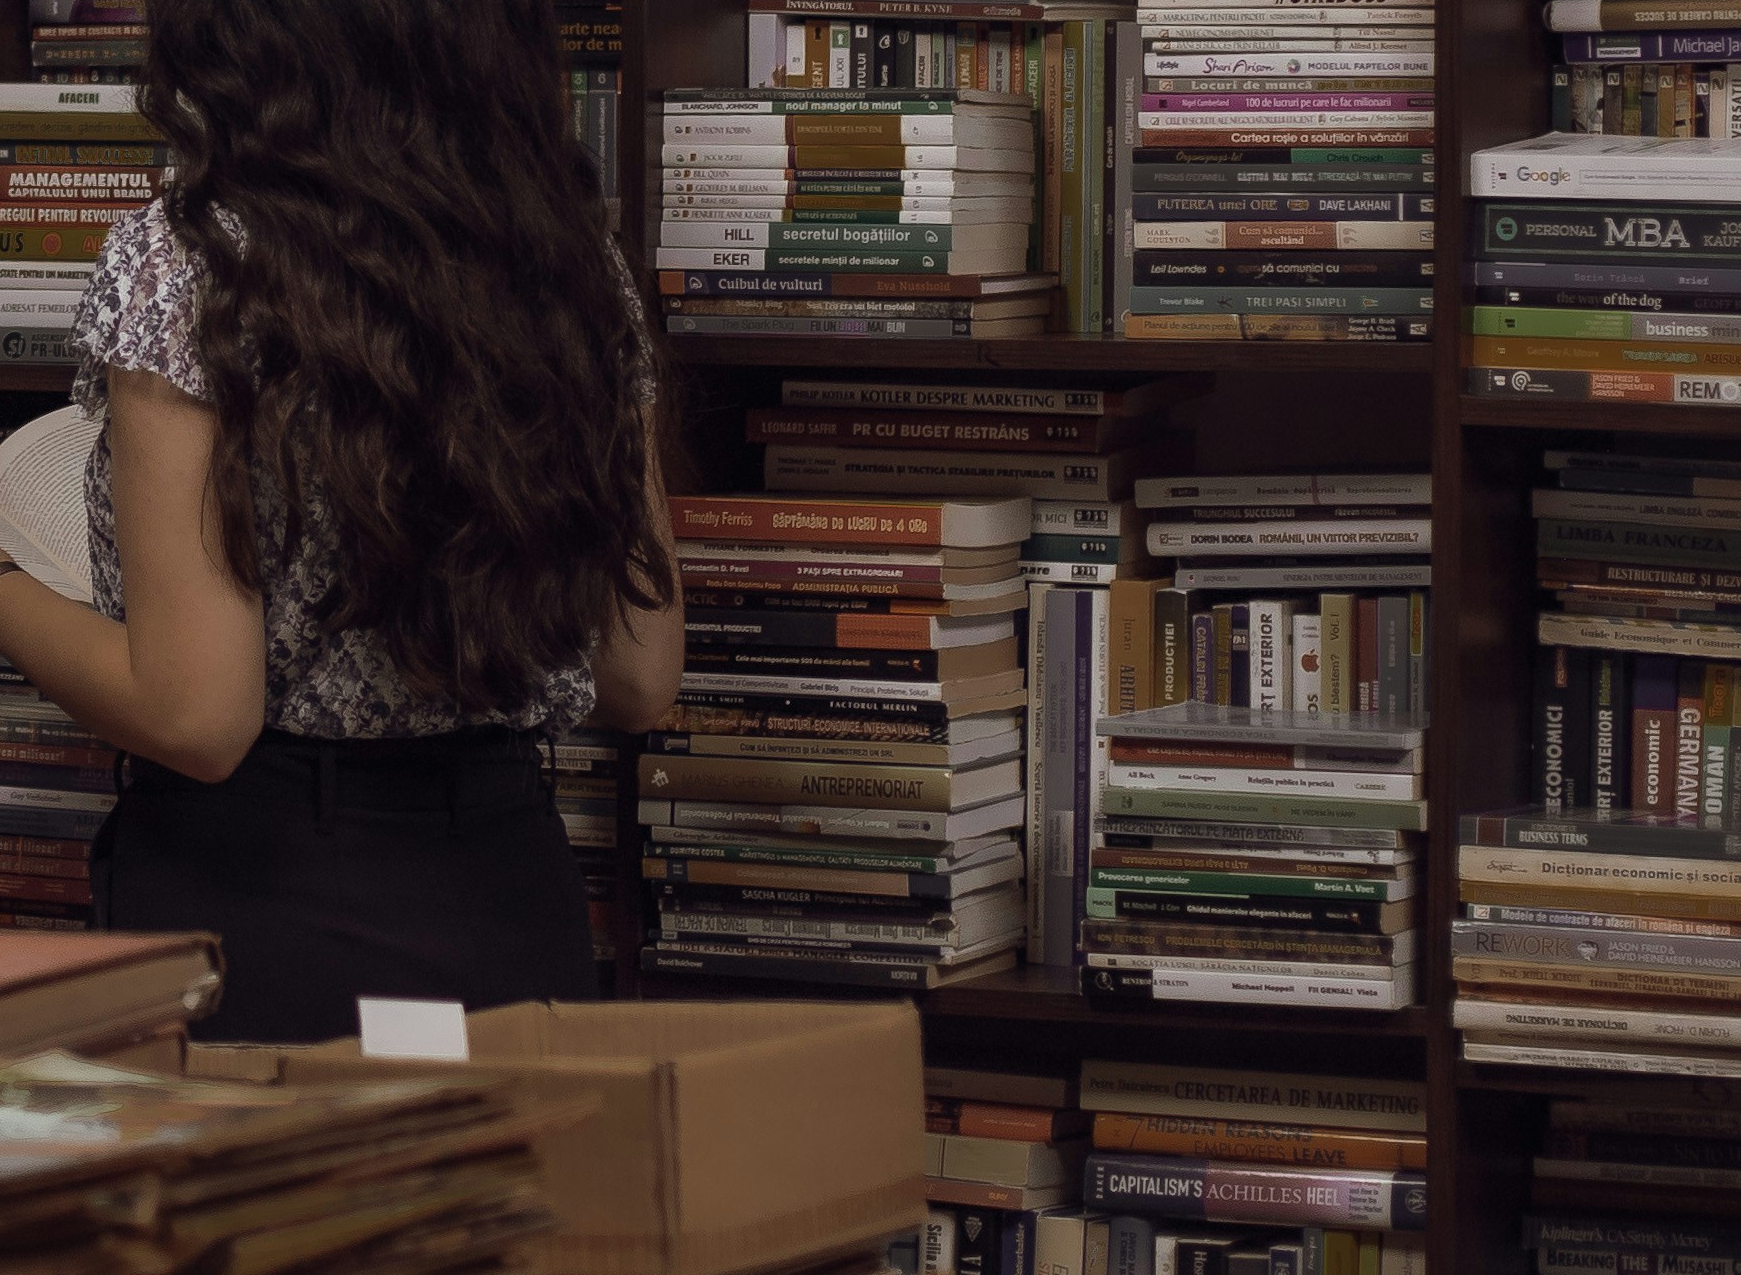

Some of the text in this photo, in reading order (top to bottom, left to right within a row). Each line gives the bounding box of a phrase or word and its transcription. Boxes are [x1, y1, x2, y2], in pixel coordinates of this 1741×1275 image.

[1673, 38, 1726, 53] Michael
[1308, 61, 1429, 71] MODELUL BUNE
[1191, 80, 1312, 91] Locuri de muncă
[58, 93, 100, 103] AFACERI
[1246, 97, 1260, 107] 100
[1262, 98, 1272, 107] de
[1274, 98, 1299, 107] lucruri
[1300, 98, 1309, 108] pe
[1310, 98, 1329, 107] care
[1331, 98, 1338, 107] le
[1340, 97, 1352, 107] fac
[1231, 133, 1270, 144] Cartea
[1272, 133, 1297, 145] roșie
[1300, 134, 1308, 143] a
[1358, 133, 1367, 142] în
[1370, 132, 1409, 143] vânzări
[10, 173, 150, 187] MANAGEMENTUL
[1517, 166, 1571, 186] Google
[8, 189, 152, 198] CAPITALULUI UNUI BRAND
[1157, 199, 1391, 211] PUTEREA unei DAVE LAKHANI
[0, 207, 78, 222] REGULI PENTRU
[724, 229, 910, 244] HILL secretul bogățiilor
[1526, 218, 1690, 247] PERSONAL MBA
[714, 254, 750, 265] EKER
[1276, 263, 1339, 274] comunici cu
[718, 278, 822, 291] Cuibul de vulturi
[1246, 297, 1347, 308] TREI SIMPLI
[1603, 294, 1662, 310] of the dog
[1646, 321, 1709, 336] business
[860, 390, 1055, 409] KOTLER DESPRE MARKETING
[852, 423, 1030, 441] PR CU BUGET RESTRÂNS
[684, 510, 753, 527] Timothy Ferriss
[1190, 535, 1253, 545] DORIN BODEA
[1556, 525, 1728, 553] LIMBA FRANCEZA
[1260, 613, 1273, 689] EXTERIOR
[1164, 623, 1175, 700] PRODUCȚIEI
[1647, 719, 1661, 805] economic
[800, 775, 924, 800] ANTREPRENORIAT
[1519, 831, 1588, 846] BUSINESS TERMS
[1542, 862, 1699, 883] Dicționar economic și
[1476, 932, 1570, 958] REWORK
[1175, 1081, 1419, 1114] CERCETAREA DE MARKETING
[1110, 1174, 1341, 1206] CAPITALISM'S ACHILLES HEEL
[1621, 1256, 1649, 1271] THE
